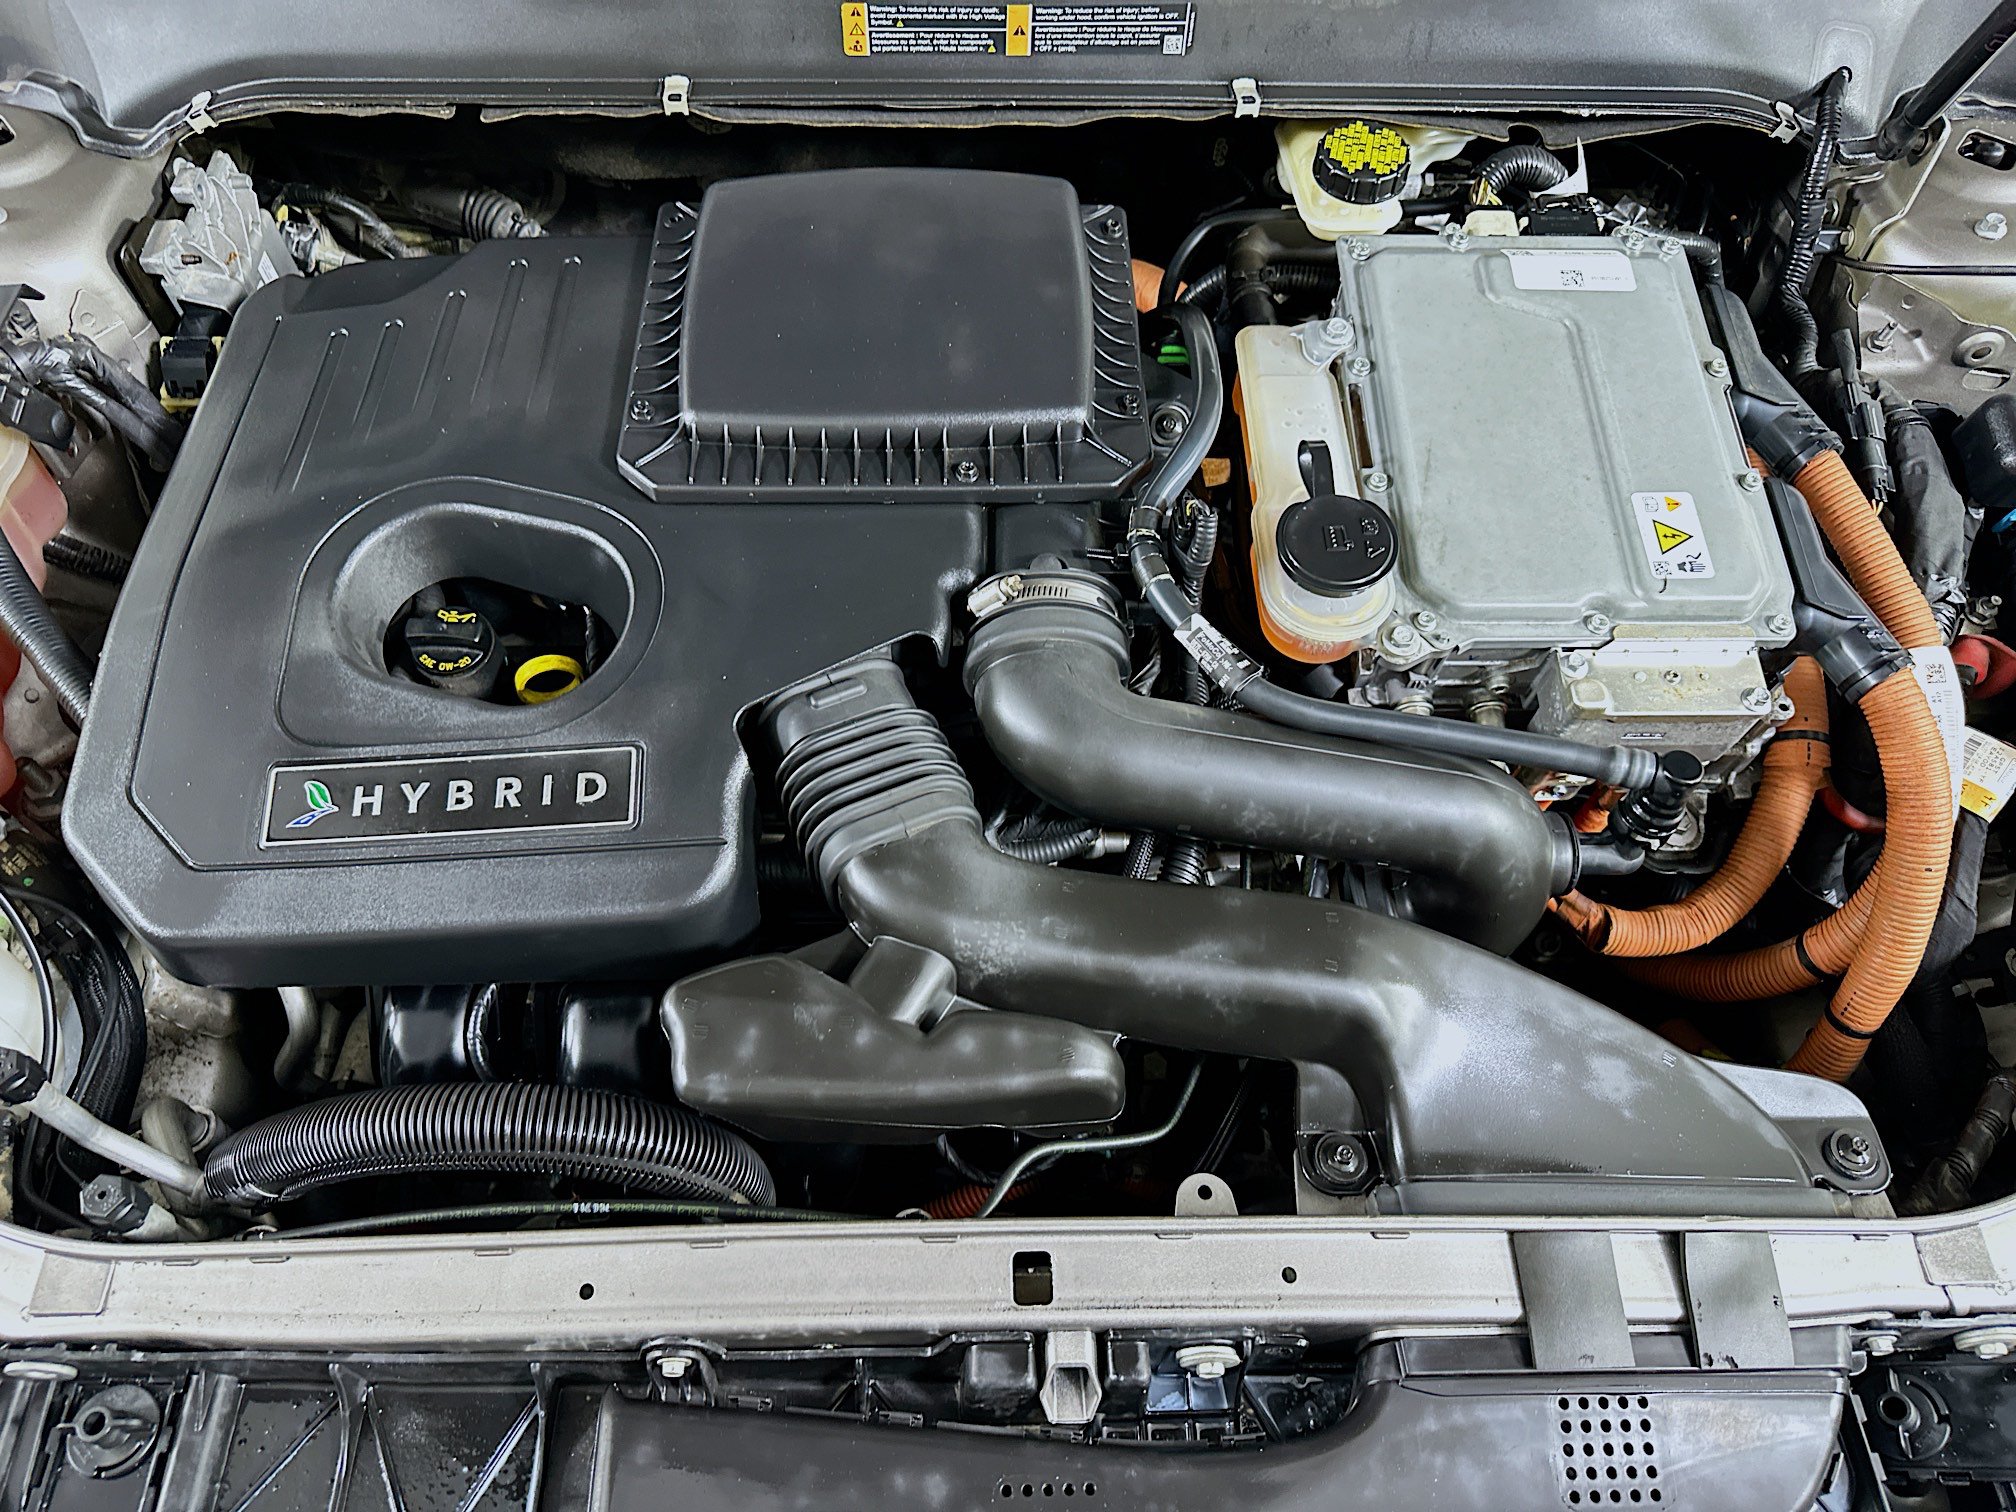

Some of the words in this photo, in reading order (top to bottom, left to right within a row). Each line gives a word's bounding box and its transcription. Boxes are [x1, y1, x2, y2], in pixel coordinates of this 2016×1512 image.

[970, 13, 982, 21] High
[984, 13, 1005, 21] Voltage
[1197, 632, 1222, 659] FoMoCo
[419, 654, 437, 668] SAE
[350, 771, 609, 819] HYBRID
